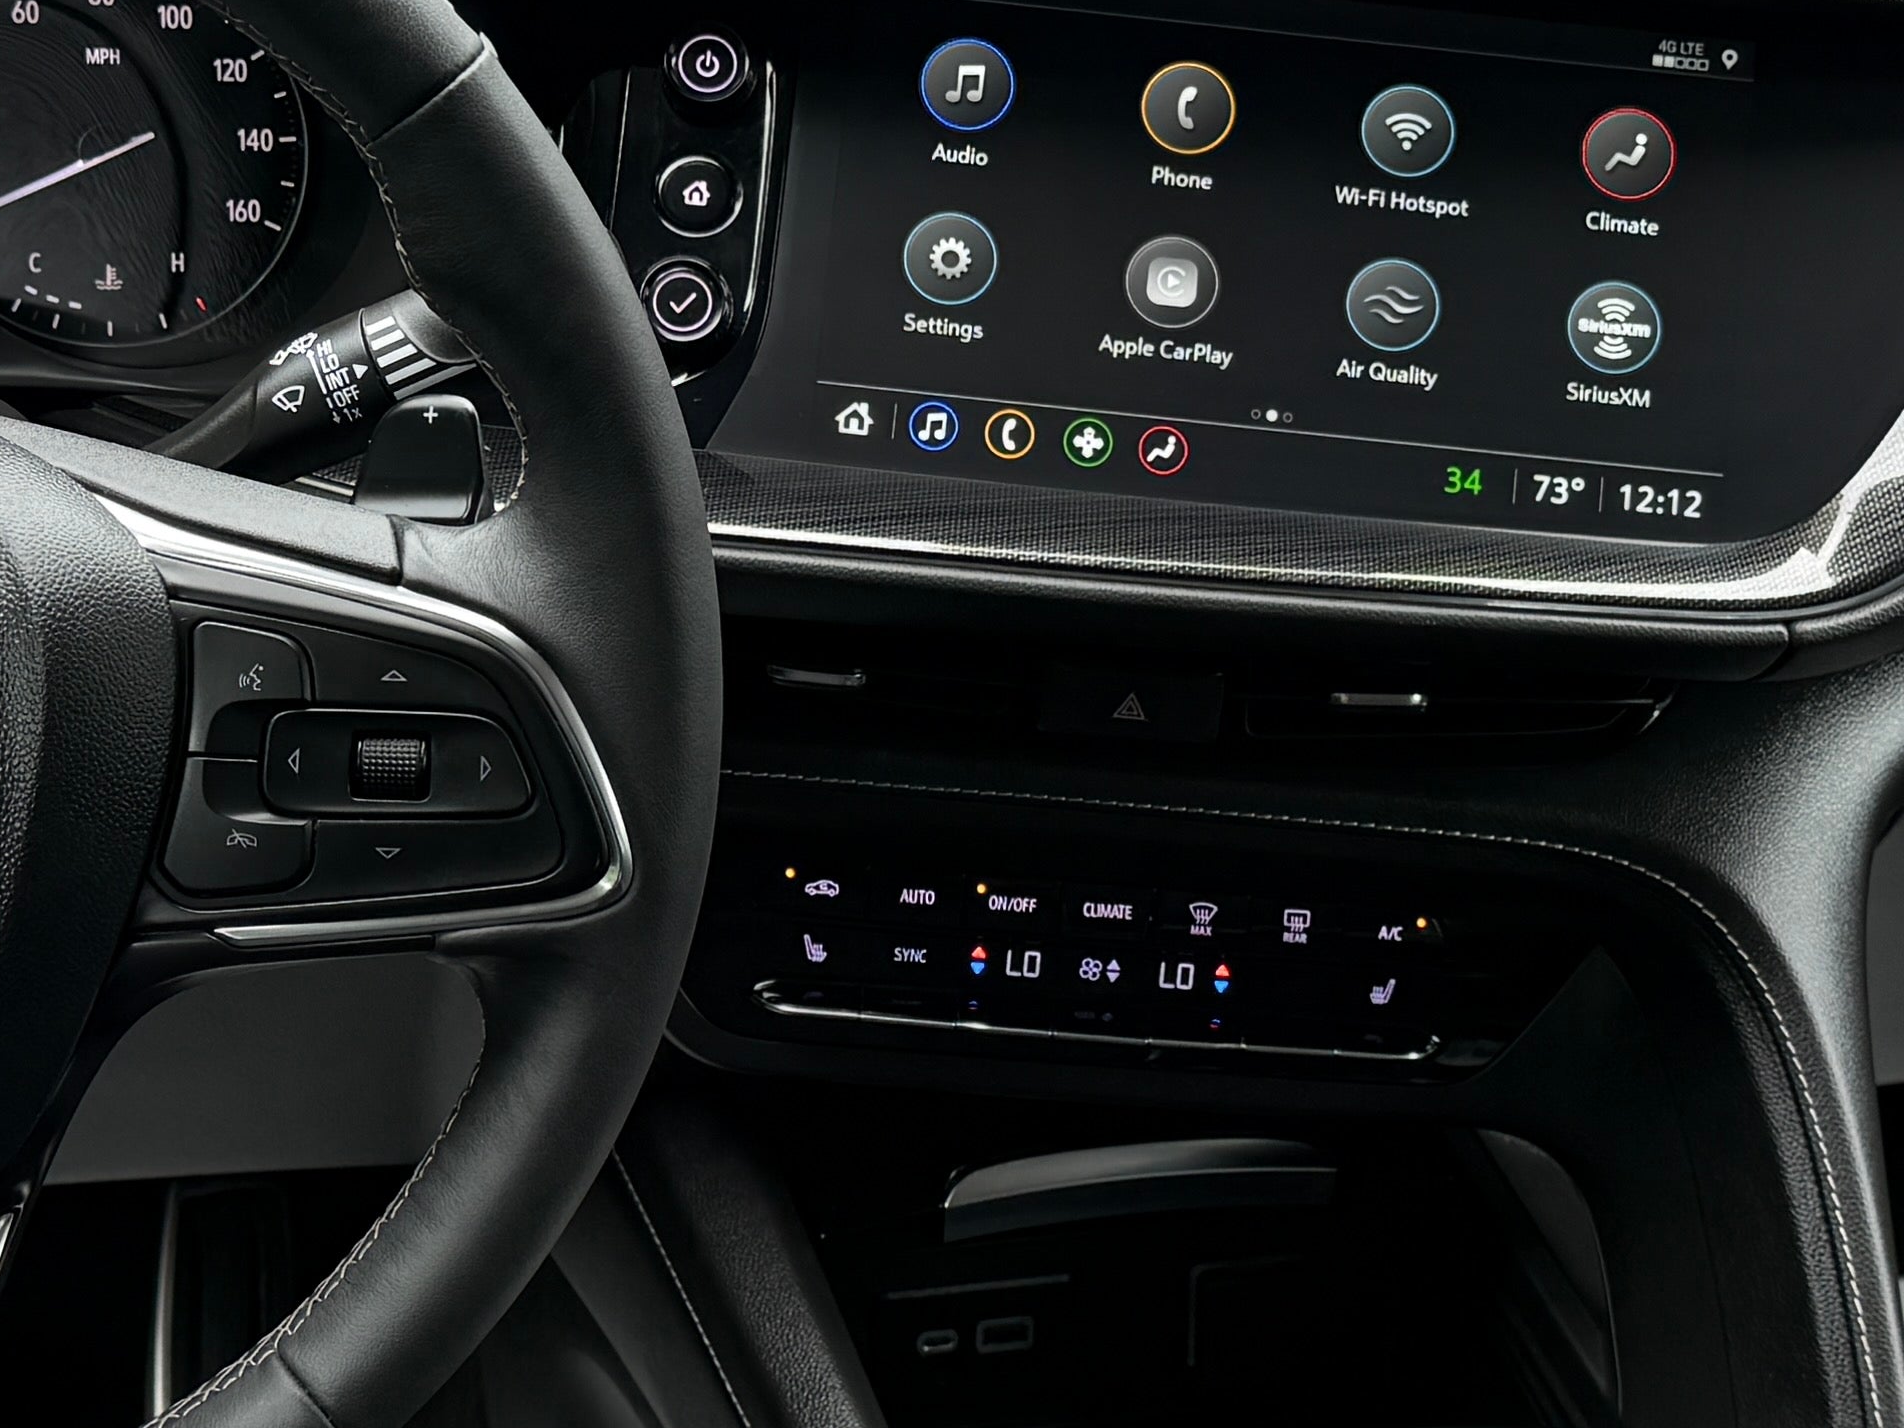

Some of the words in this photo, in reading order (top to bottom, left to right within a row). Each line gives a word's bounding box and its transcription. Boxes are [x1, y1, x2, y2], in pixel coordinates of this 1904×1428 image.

[11, 0, 40, 26] 60
[157, 5, 194, 31] 100
[85, 47, 121, 67] MPH
[1658, 39, 1677, 55] 4G
[1680, 41, 1705, 57] LTE
[213, 58, 248, 83] 120
[237, 128, 274, 153] 140
[931, 142, 989, 167] Audio
[1151, 165, 1213, 191] Phone
[226, 199, 262, 224] 160
[1334, 184, 1387, 210] Wi-Fi
[1389, 191, 1470, 219] Hotspot
[1585, 210, 1660, 238] Climate
[28, 252, 42, 274] C
[171, 252, 185, 273] H
[902, 312, 984, 342] Settings
[316, 339, 333, 358] HI
[1098, 333, 1155, 361] Apple
[1159, 340, 1234, 371] CarPlay
[320, 354, 340, 373] LO
[1335, 357, 1365, 380] Air
[1368, 360, 1439, 392] Quality
[325, 366, 350, 391] INT
[335, 384, 360, 409] OFF
[1566, 382, 1652, 409] SiriusXM
[1443, 466, 1483, 496] 34
[1619, 483, 1703, 519] 12:12
[899, 887, 936, 906] AUTO
[988, 894, 1038, 914] ON/OFF
[1082, 901, 1134, 922] CLIMATE
[1377, 925, 1404, 943] A/C
[893, 947, 927, 964] SYNC
[1005, 949, 1042, 979] LO
[1158, 960, 1195, 991] LO
